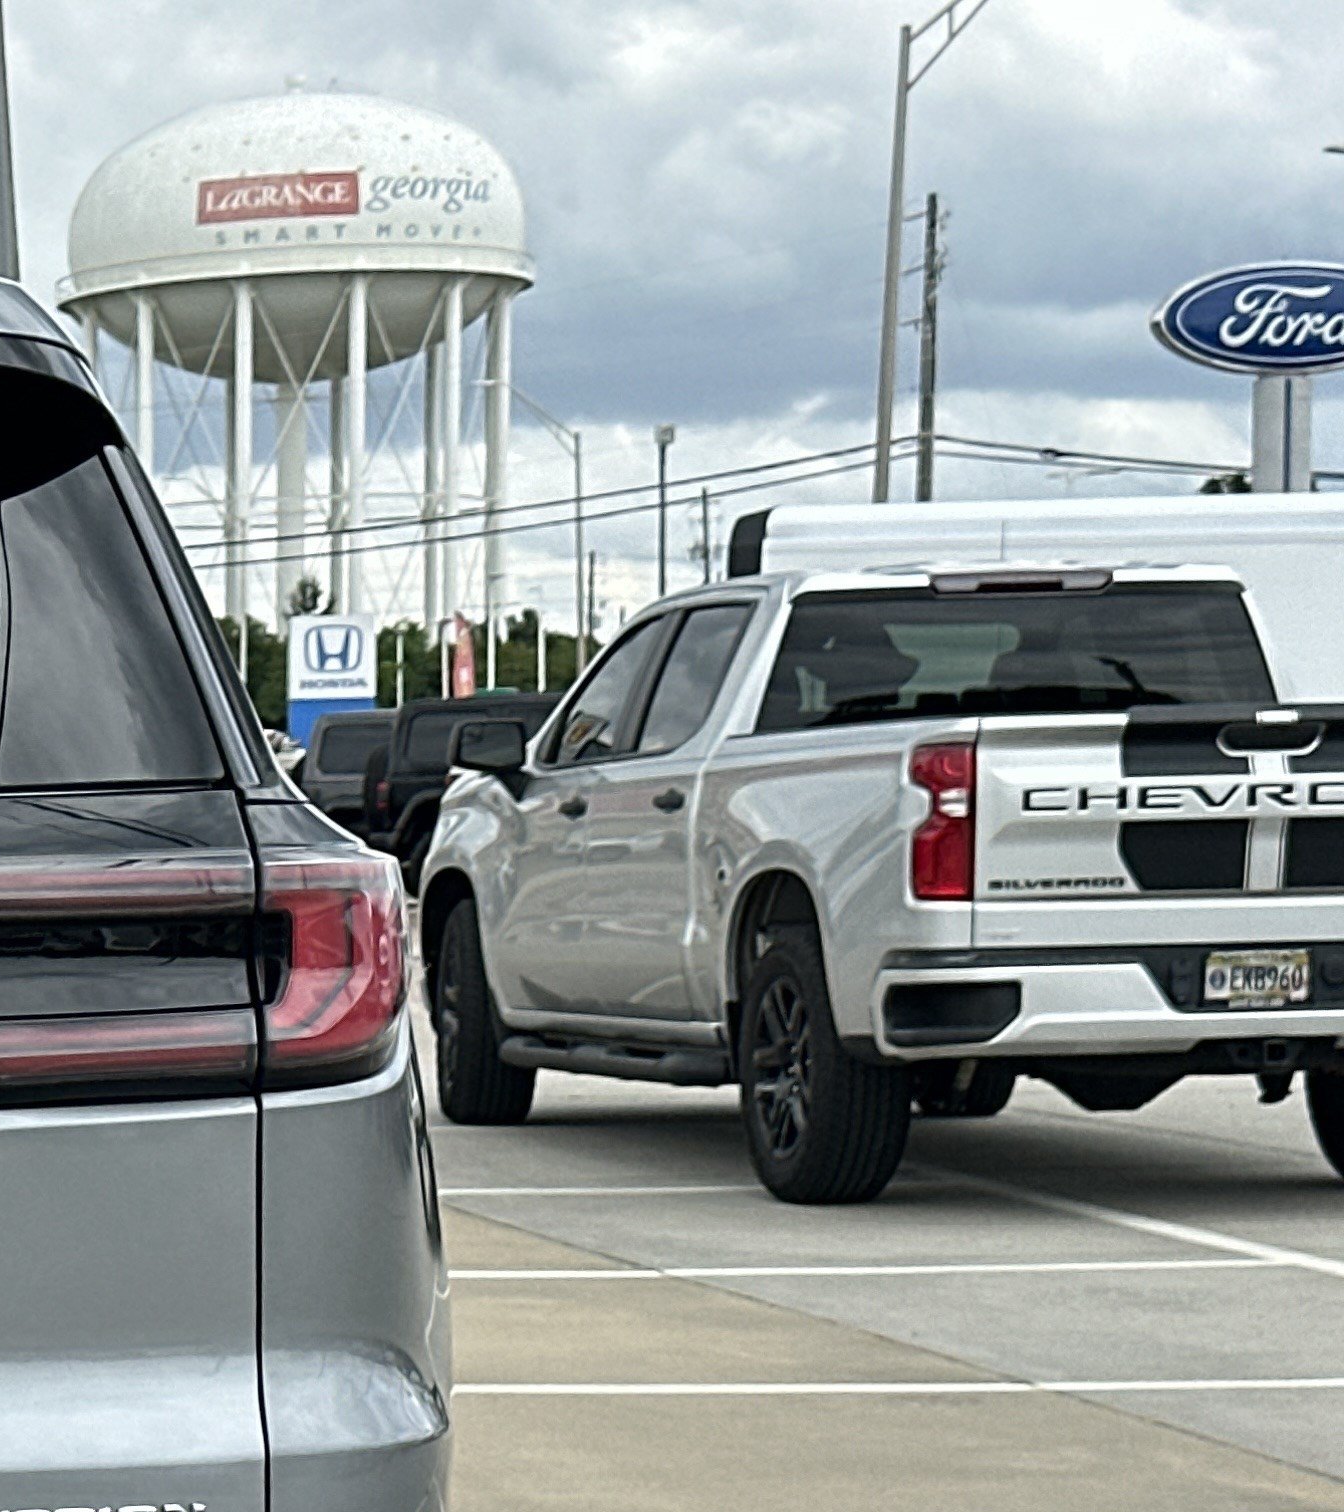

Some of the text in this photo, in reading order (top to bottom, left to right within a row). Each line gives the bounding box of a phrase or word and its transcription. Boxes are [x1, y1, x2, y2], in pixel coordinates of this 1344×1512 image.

[364, 174, 490, 214] georgia
[215, 223, 347, 245] SMART
[299, 678, 368, 689] HONDA
[987, 877, 1127, 890] SILVERADO
